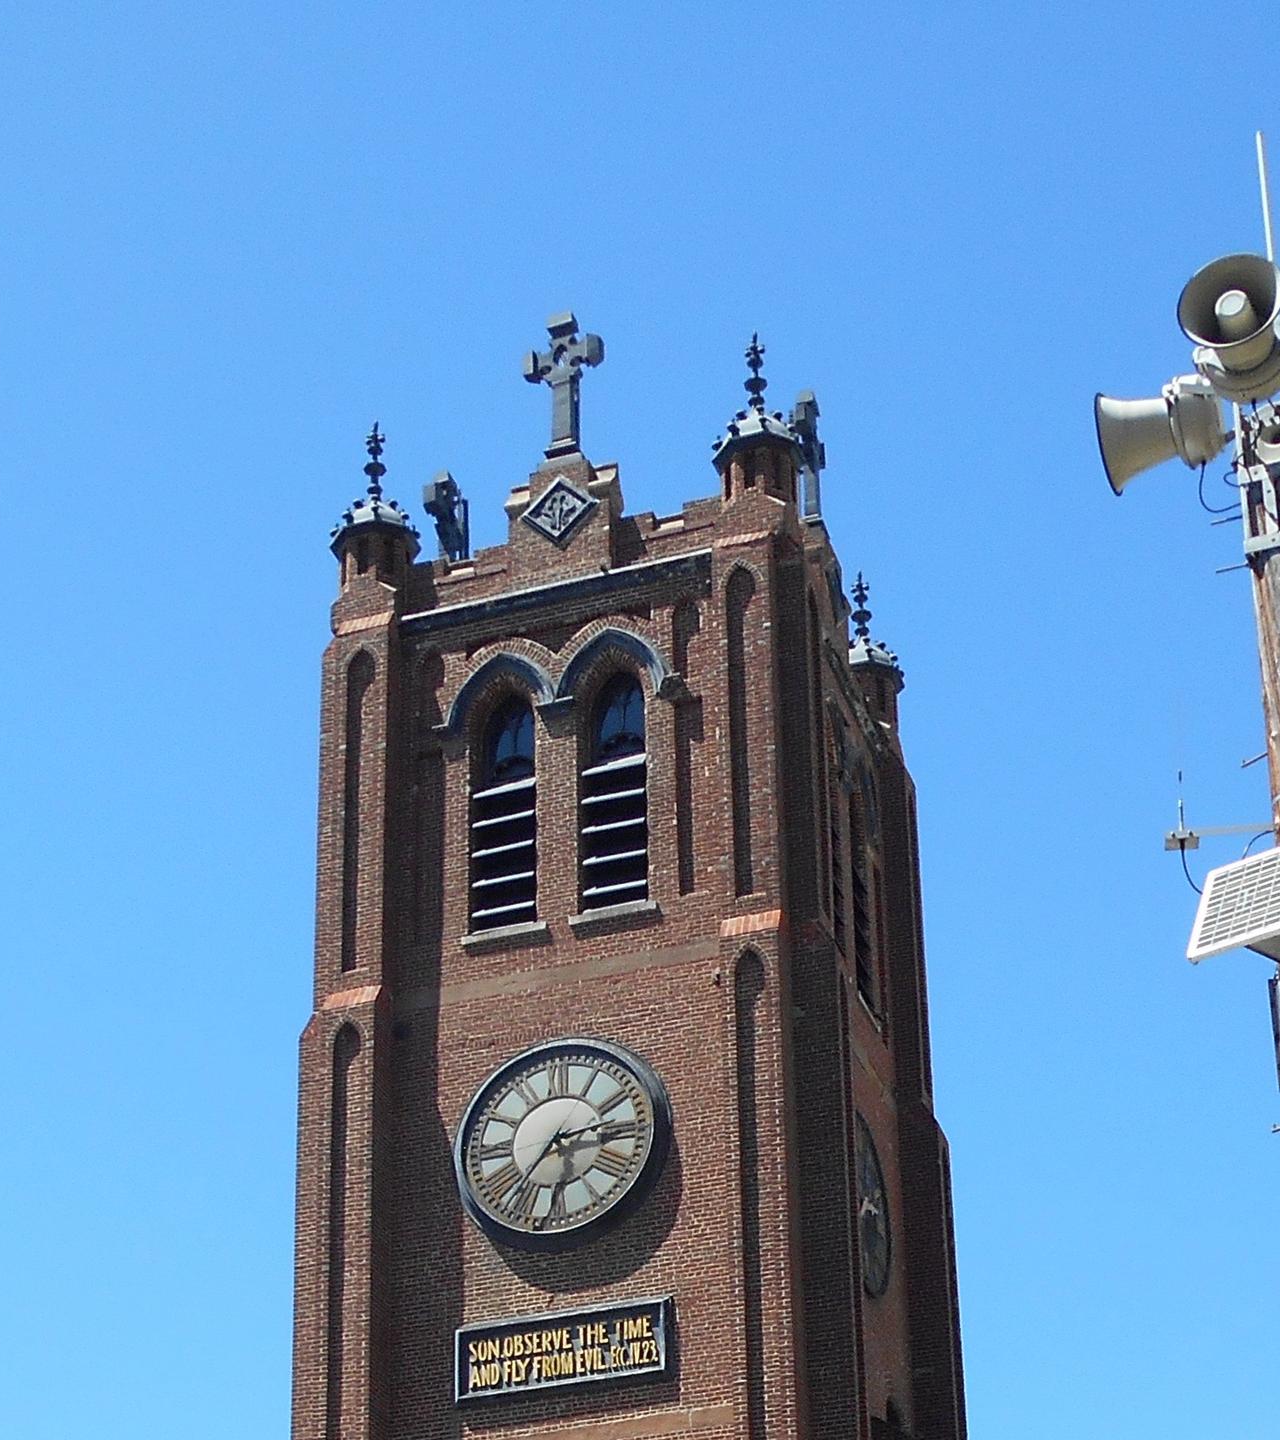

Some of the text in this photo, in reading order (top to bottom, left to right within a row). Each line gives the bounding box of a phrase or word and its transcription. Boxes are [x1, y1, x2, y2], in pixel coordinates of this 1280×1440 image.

[577, 1320, 609, 1347] THE
[612, 1314, 653, 1341] TIME
[468, 1362, 500, 1389] AND
[503, 1357, 531, 1383] FLY
[533, 1350, 574, 1380] FROM
